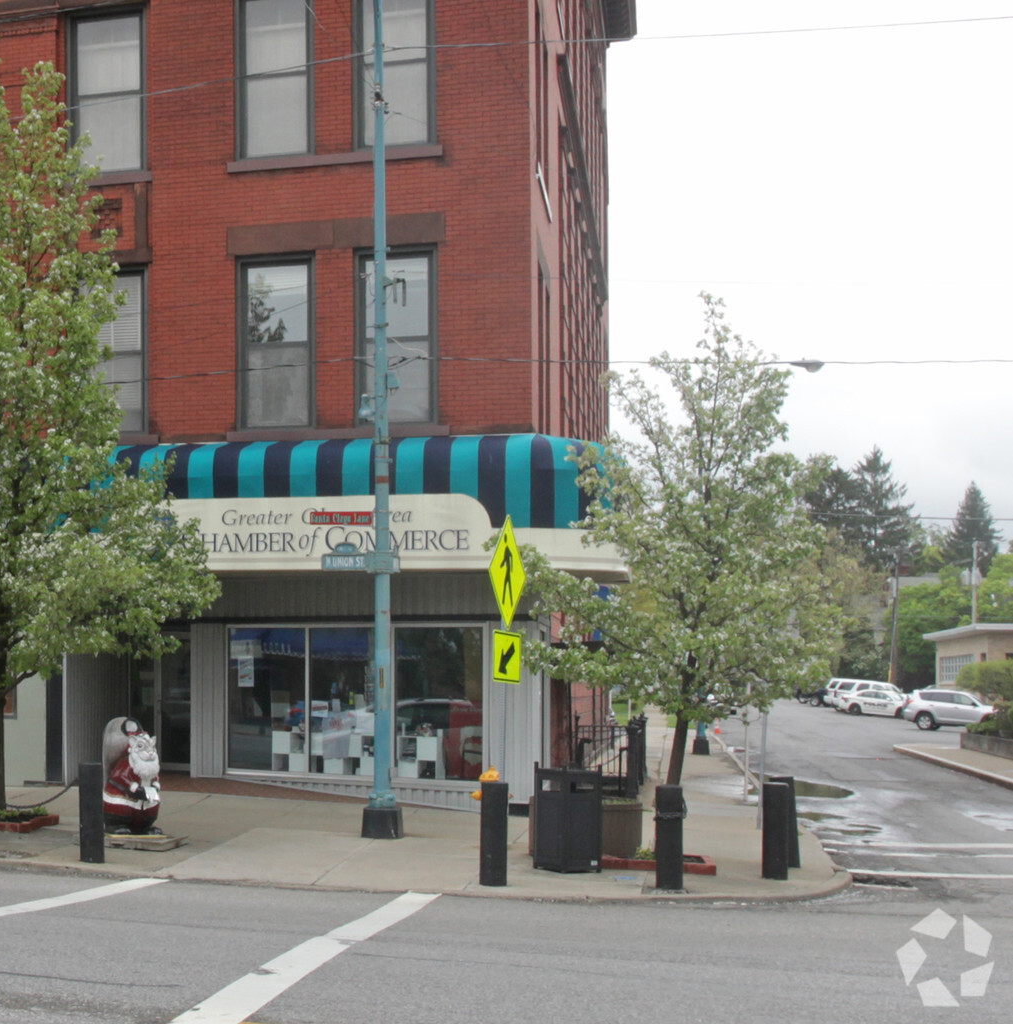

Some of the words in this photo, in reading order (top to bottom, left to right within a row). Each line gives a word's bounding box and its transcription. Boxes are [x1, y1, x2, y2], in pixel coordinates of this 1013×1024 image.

[221, 509, 293, 526] Greater
[298, 526, 322, 556] of
[332, 556, 354, 567] UNION
